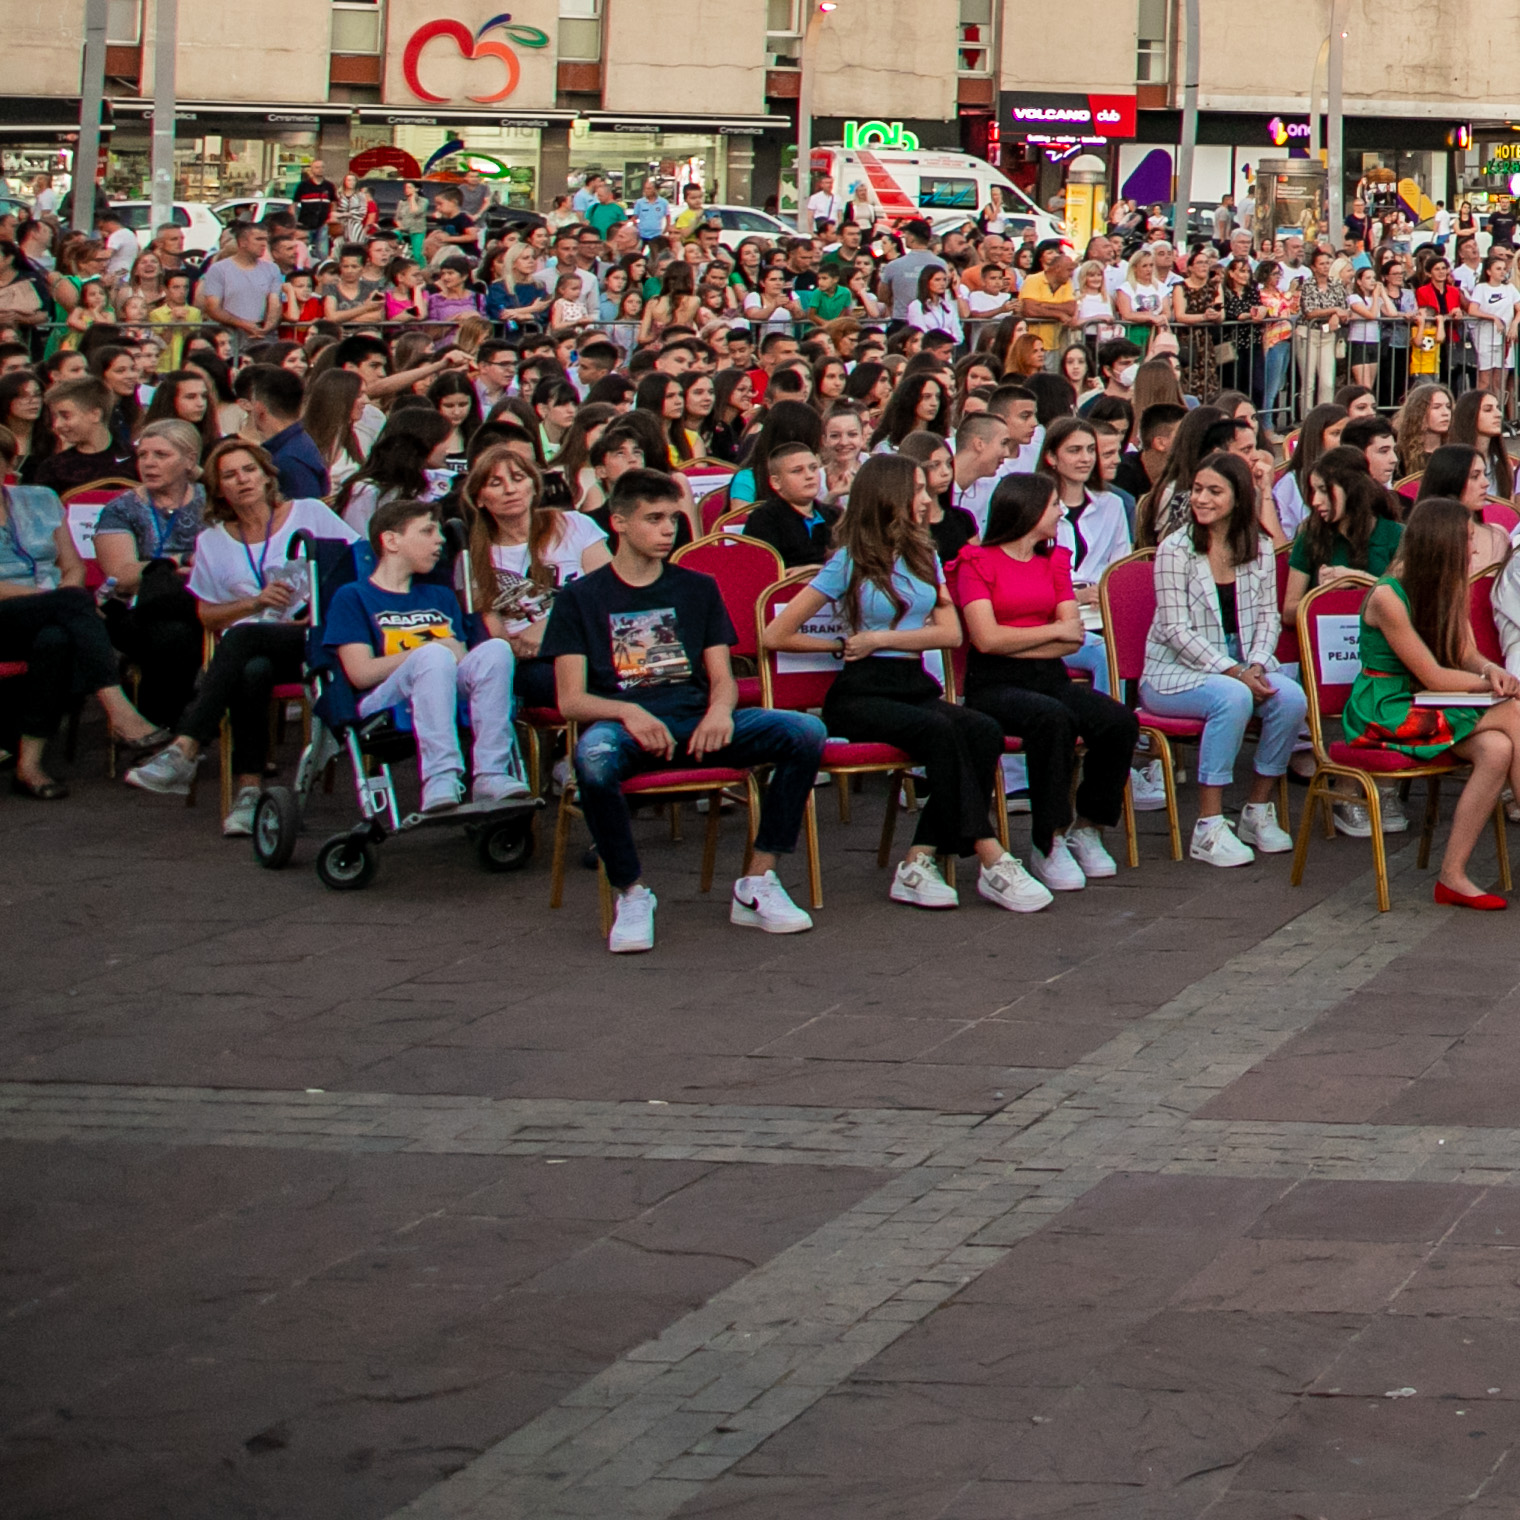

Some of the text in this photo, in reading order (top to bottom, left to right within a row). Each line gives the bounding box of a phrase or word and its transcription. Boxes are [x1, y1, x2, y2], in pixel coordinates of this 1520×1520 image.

[1013, 107, 1120, 122] VOLCANO club
[378, 613, 443, 626] ABARTH
